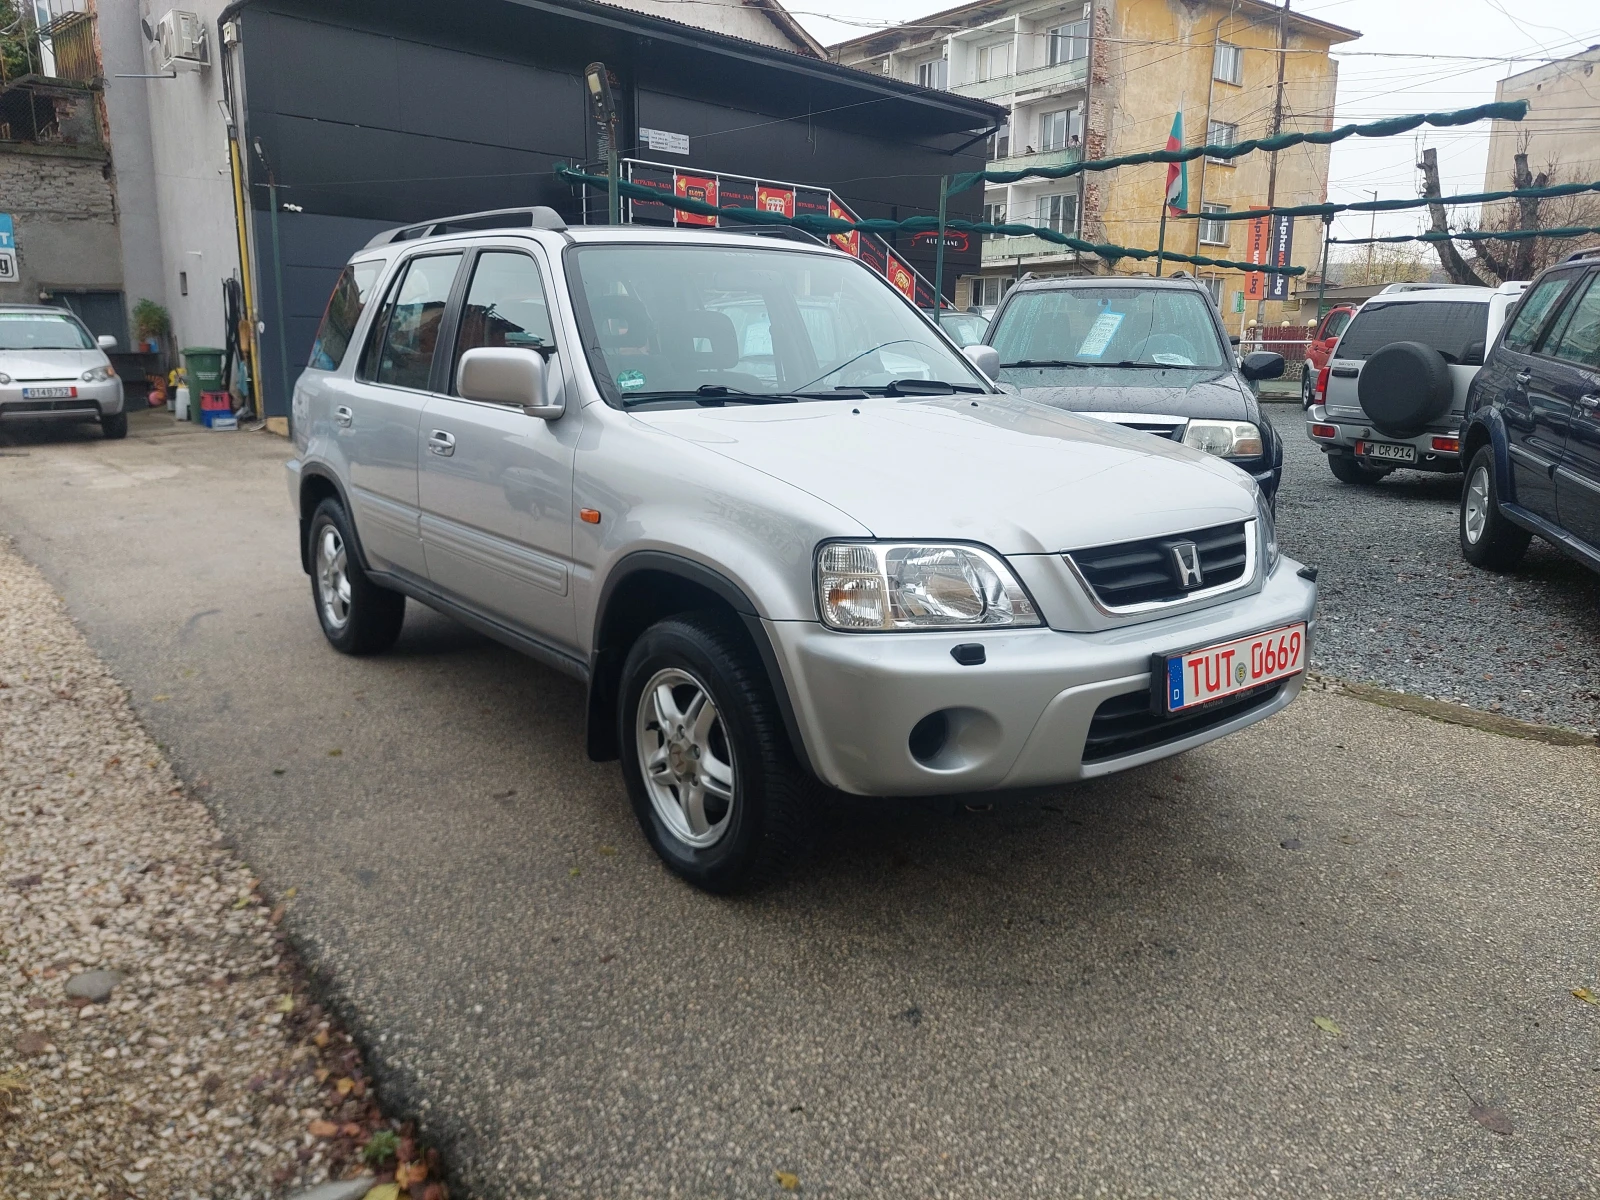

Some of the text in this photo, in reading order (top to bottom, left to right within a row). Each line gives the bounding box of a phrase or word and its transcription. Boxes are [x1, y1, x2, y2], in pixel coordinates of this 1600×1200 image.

[767, 202, 784, 211] 777
[925, 238, 959, 247] AUTLAND
[1274, 215, 1289, 295] alphawi.bg
[1379, 445, 1391, 456] CR
[1393, 447, 1412, 459] 914
[1173, 689, 1180, 700] D
[1187, 649, 1235, 697] TUT
